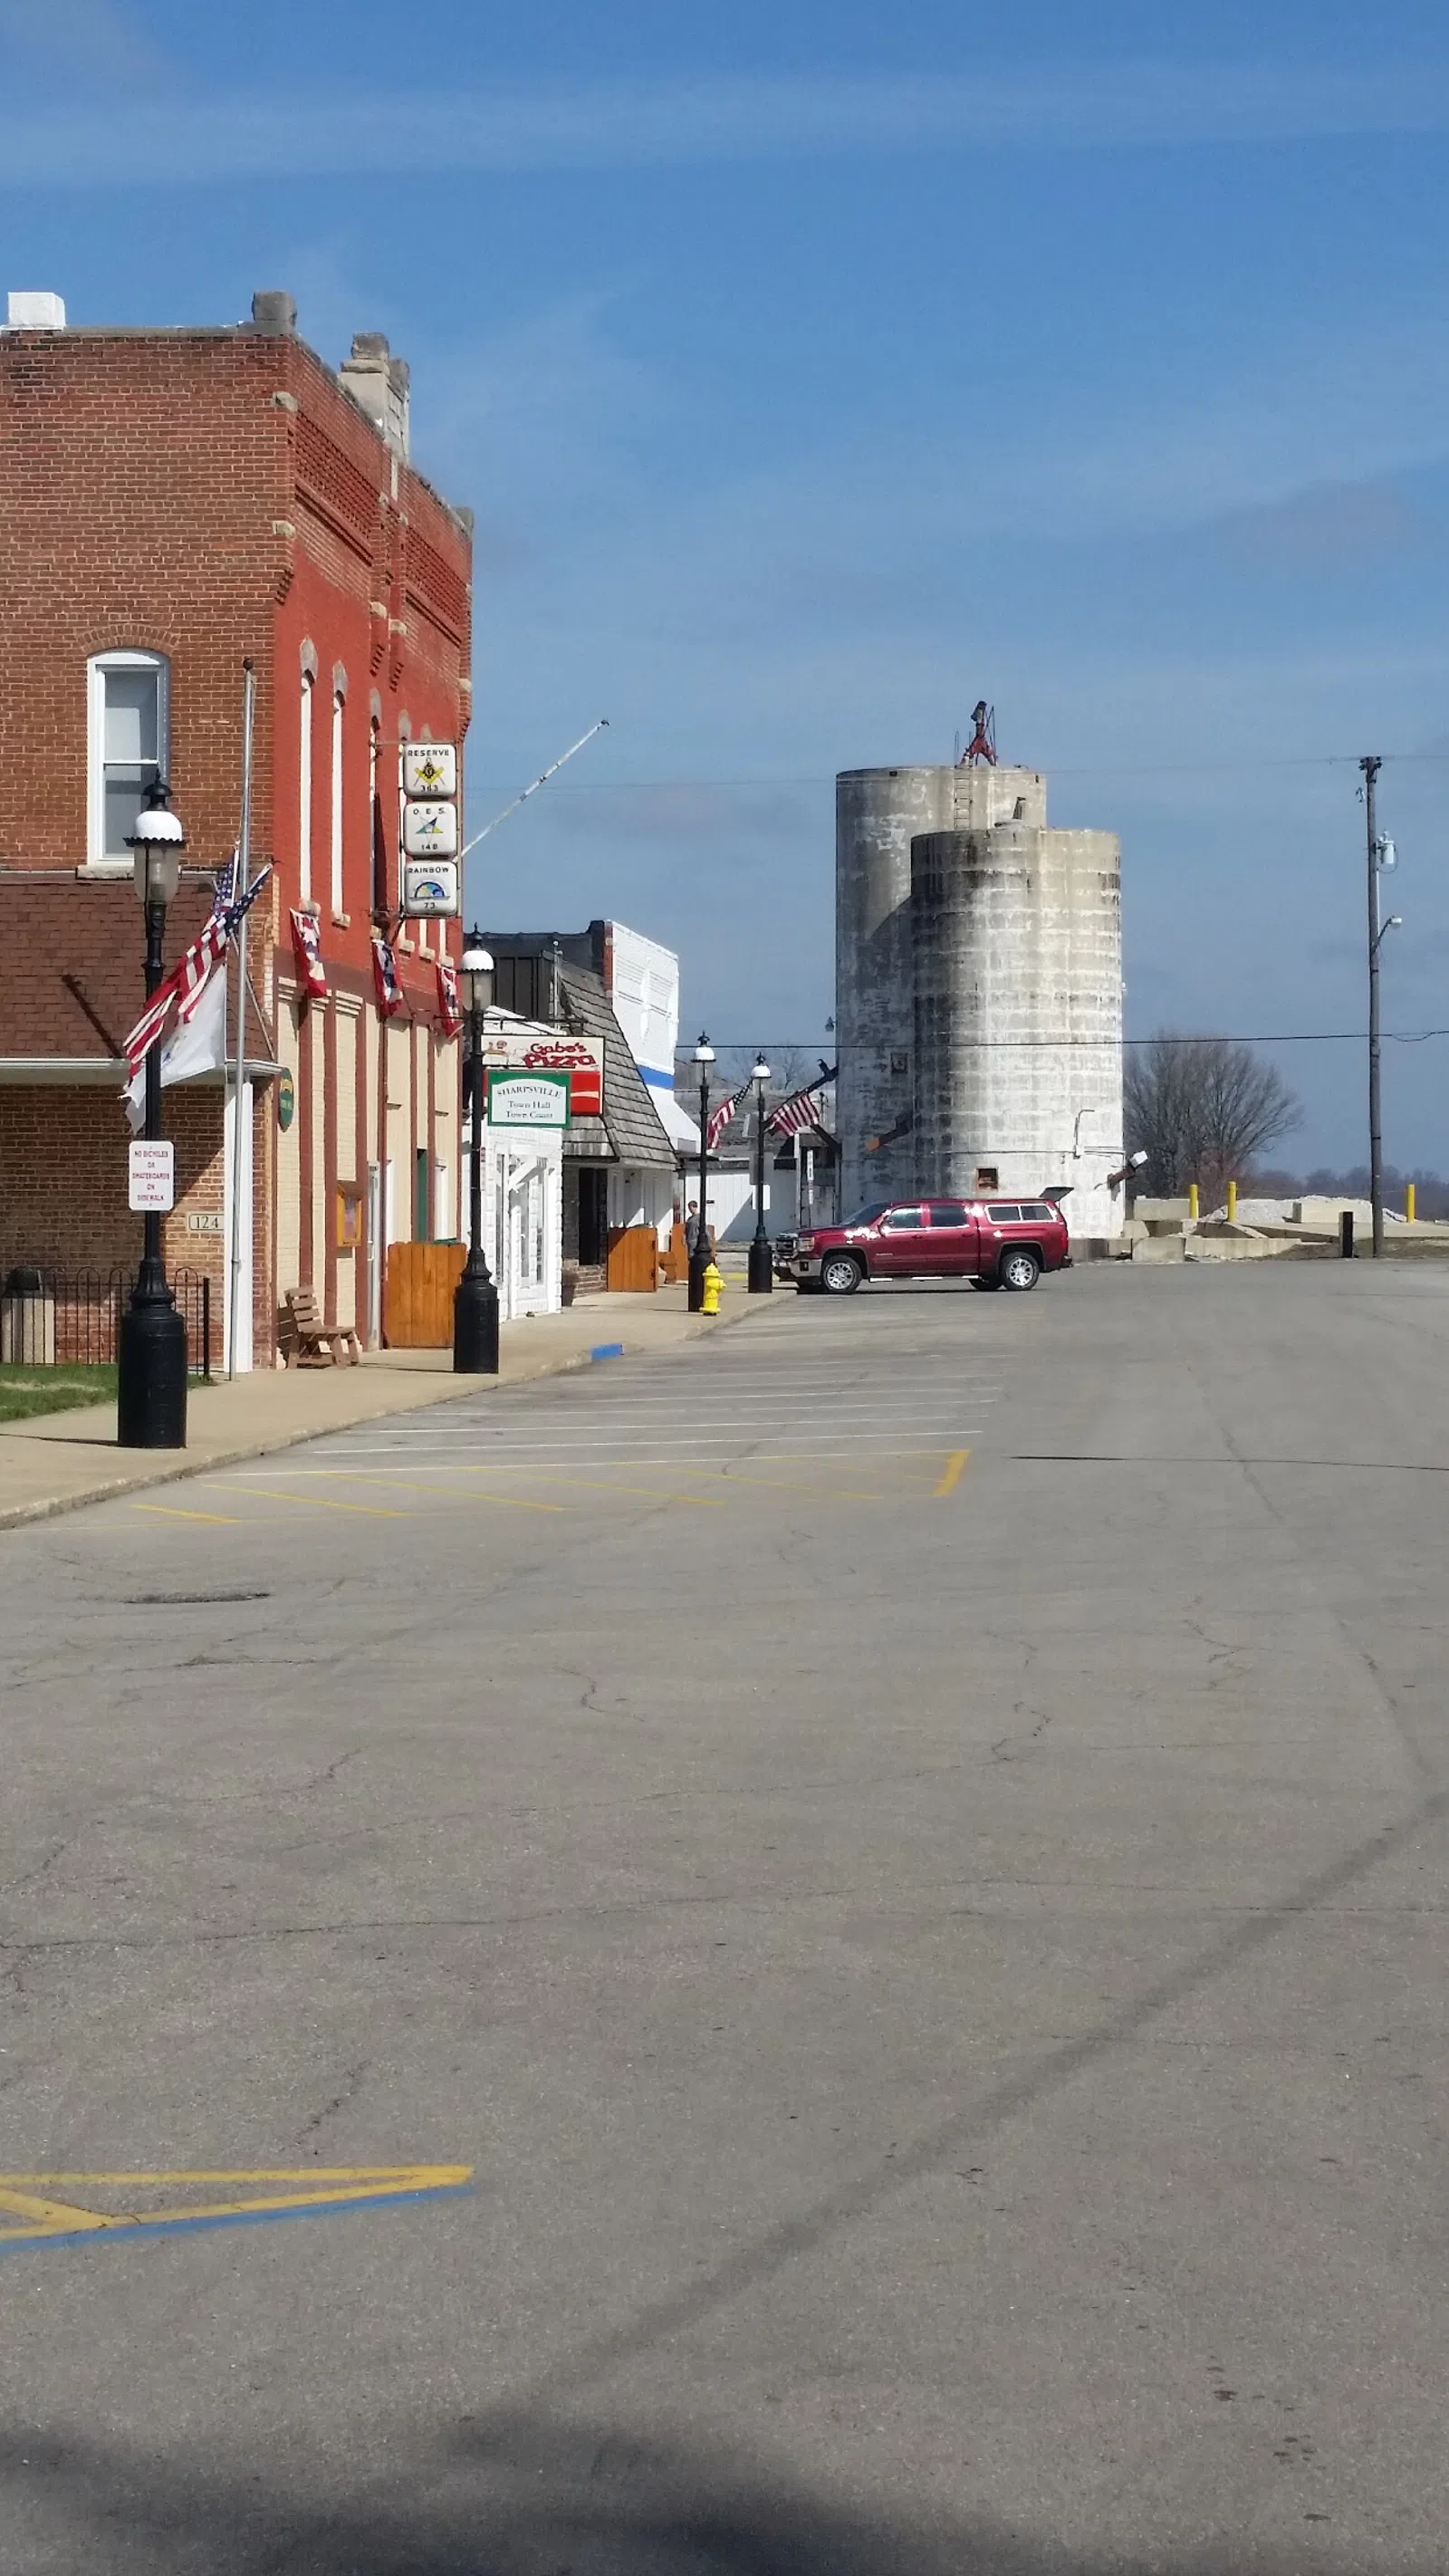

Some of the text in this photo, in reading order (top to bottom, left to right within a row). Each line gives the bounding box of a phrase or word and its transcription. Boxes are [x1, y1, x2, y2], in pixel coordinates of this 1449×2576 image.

[407, 748, 450, 757] RESERVE
[530, 1042, 587, 1055] Gabe's
[523, 1053, 597, 1068] Pizza
[495, 1086, 561, 1098] SHARPSVILLE
[508, 1101, 551, 1109] Town Hall
[197, 1216, 219, 1229] 124
